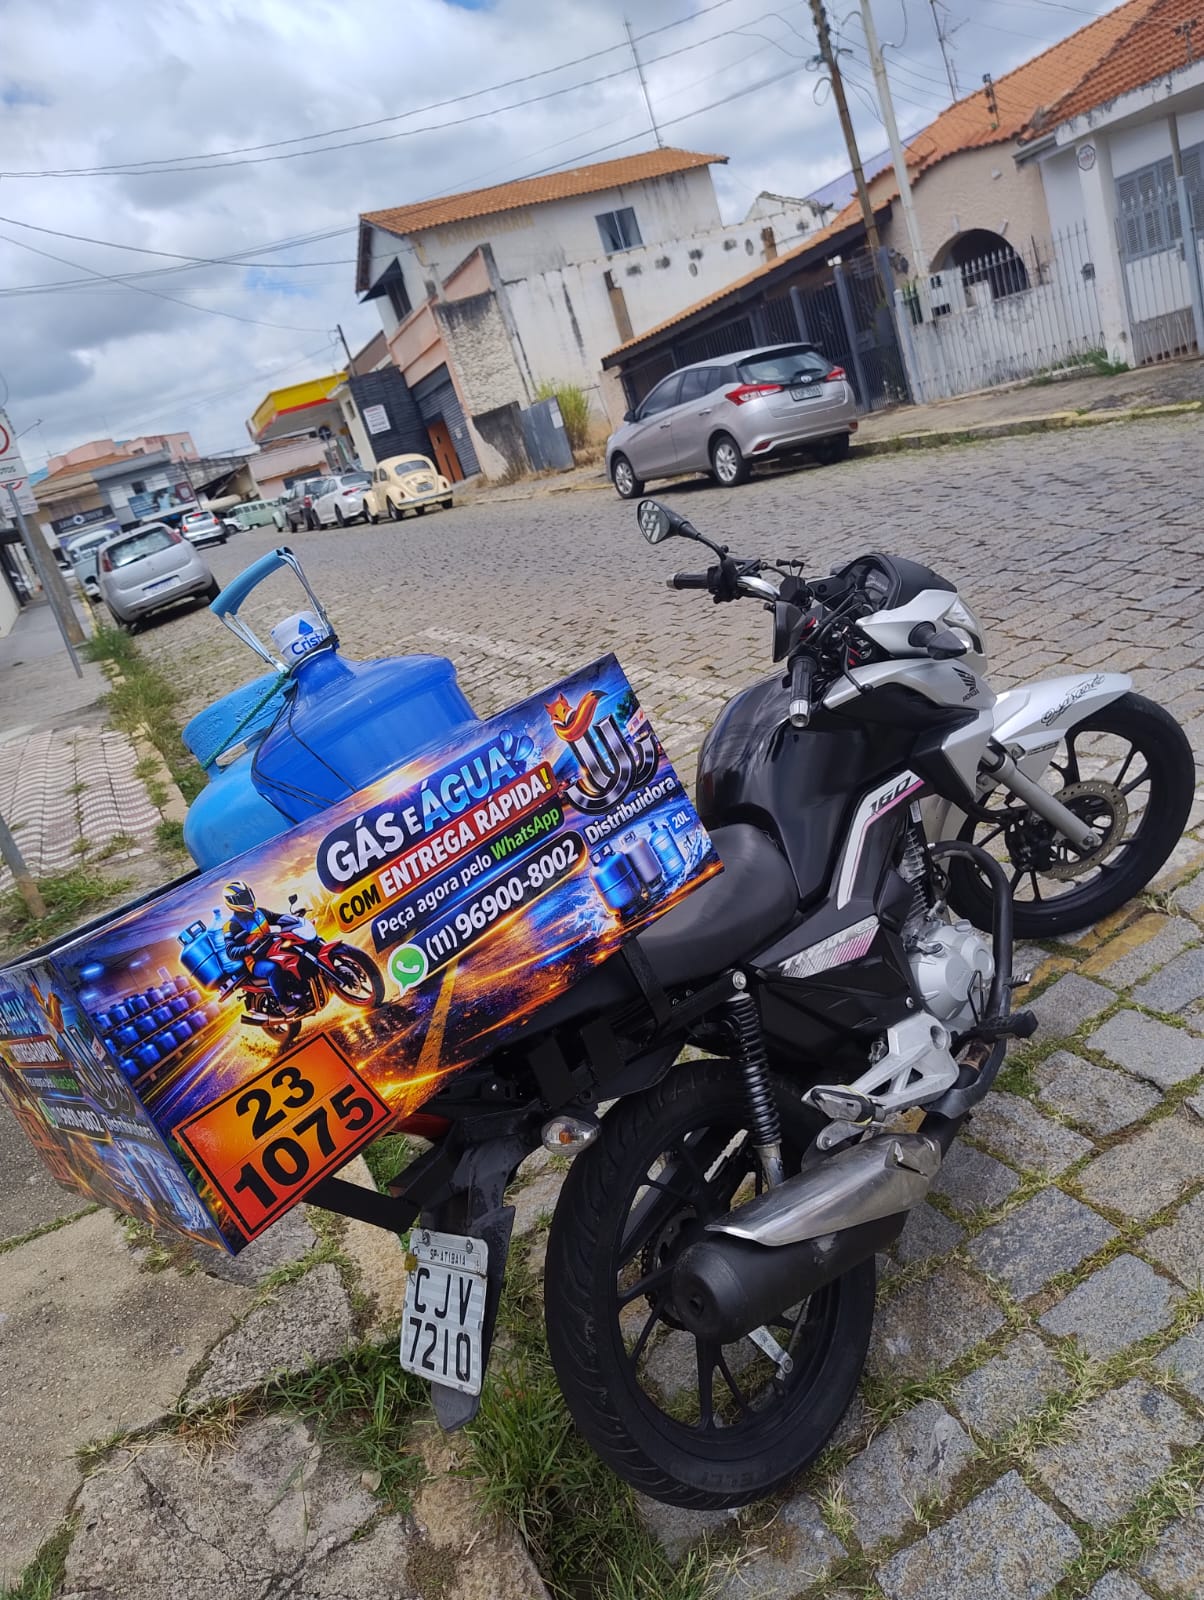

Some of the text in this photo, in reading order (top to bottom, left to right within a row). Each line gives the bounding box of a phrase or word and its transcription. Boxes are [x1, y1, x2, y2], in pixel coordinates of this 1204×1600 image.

[326, 746, 516, 881] GÁS E ÁGUA
[339, 767, 552, 924] COM ENTREGA RÁPIDA!
[584, 776, 676, 844] Distribuidora
[672, 811, 691, 829] 20L
[376, 808, 559, 939] Peça agora pelo WhatsApp
[426, 839, 579, 960] (11) 96900-8002
[234, 1084, 374, 1209] 1075
[235, 1066, 315, 1140] 23
[414, 1267, 473, 1326] CJV
[409, 1316, 471, 1382] 7210
